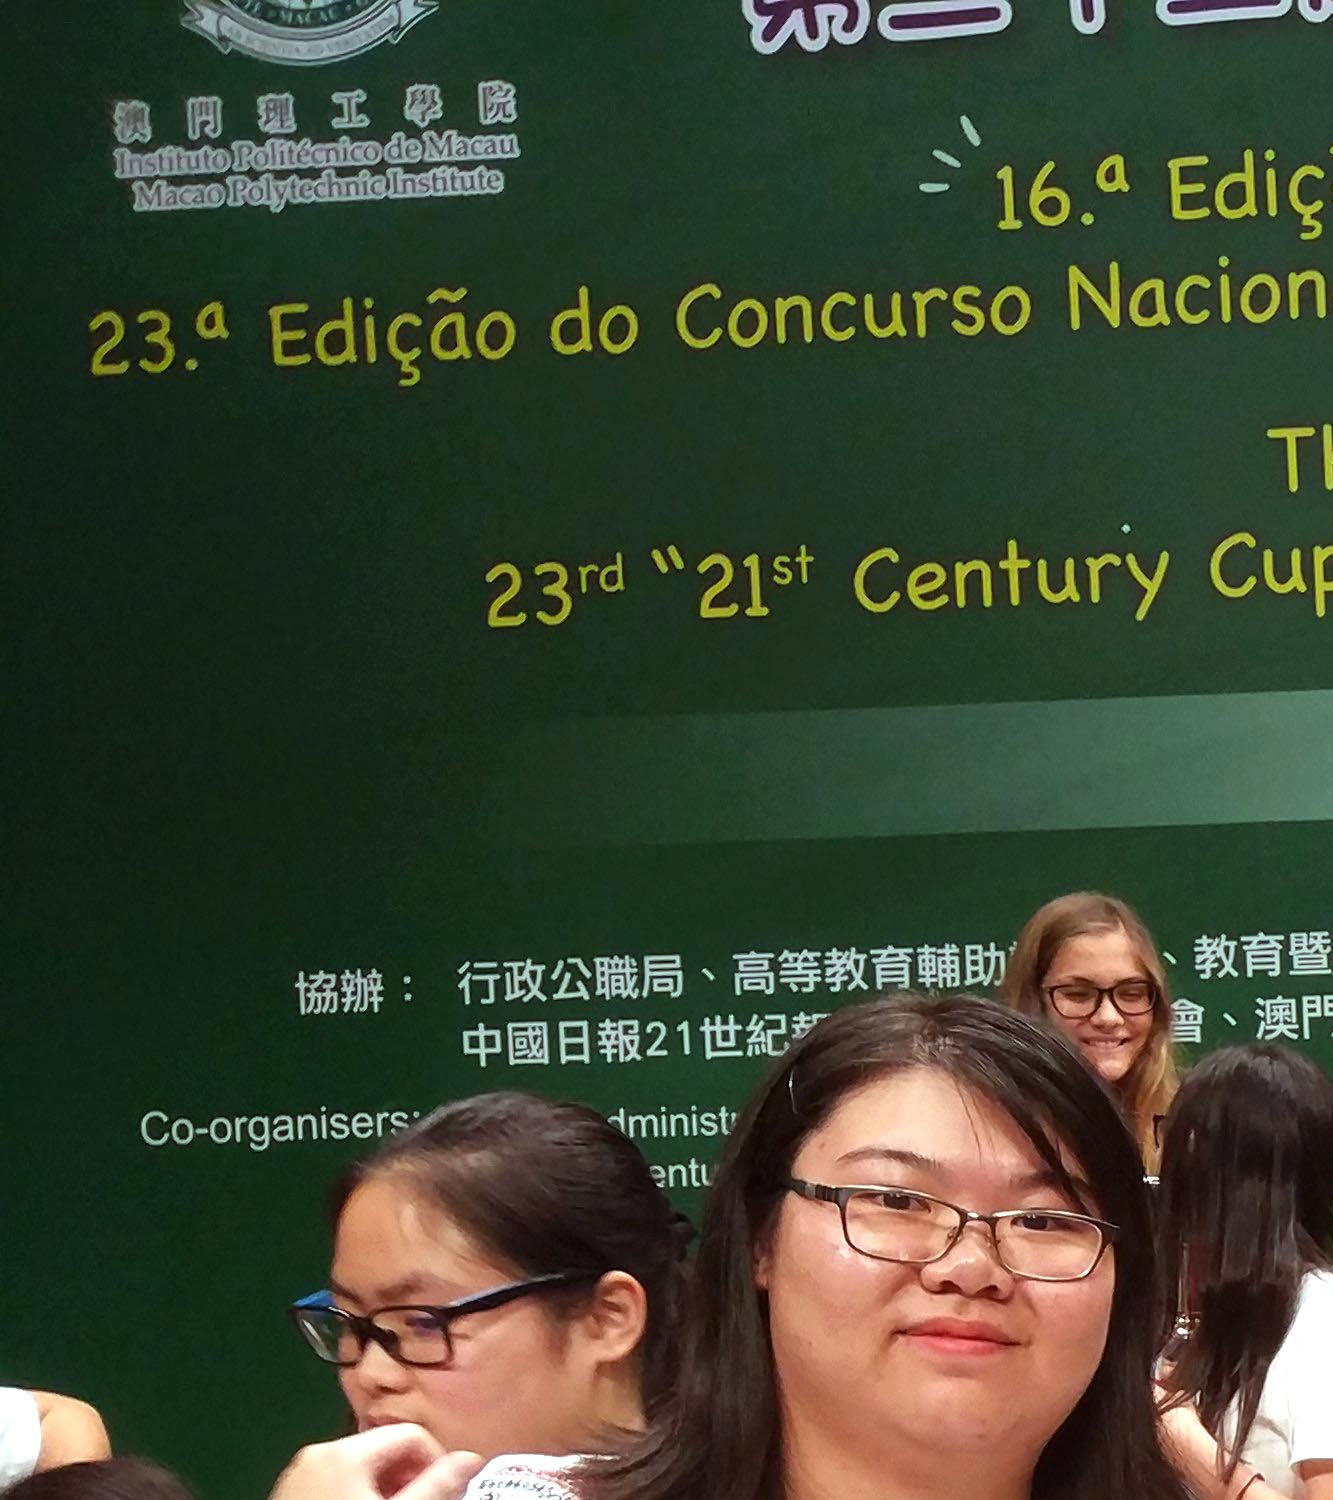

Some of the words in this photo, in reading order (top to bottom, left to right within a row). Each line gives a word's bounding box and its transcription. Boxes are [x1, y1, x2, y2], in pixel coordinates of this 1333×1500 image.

[114, 147, 232, 178] Instituto
[233, 137, 382, 171] Politécnico
[385, 132, 422, 163] de
[422, 130, 519, 161] Macau
[133, 180, 226, 211] Macao
[227, 169, 387, 213] Polytechnic
[387, 164, 504, 196] Institute
[267, 286, 517, 387] Edição
[549, 284, 640, 356] do
[675, 282, 1033, 350] Concurso
[852, 538, 1171, 623] Century
[457, 943, 1014, 1006] 行政公職局、高等教育輔助
